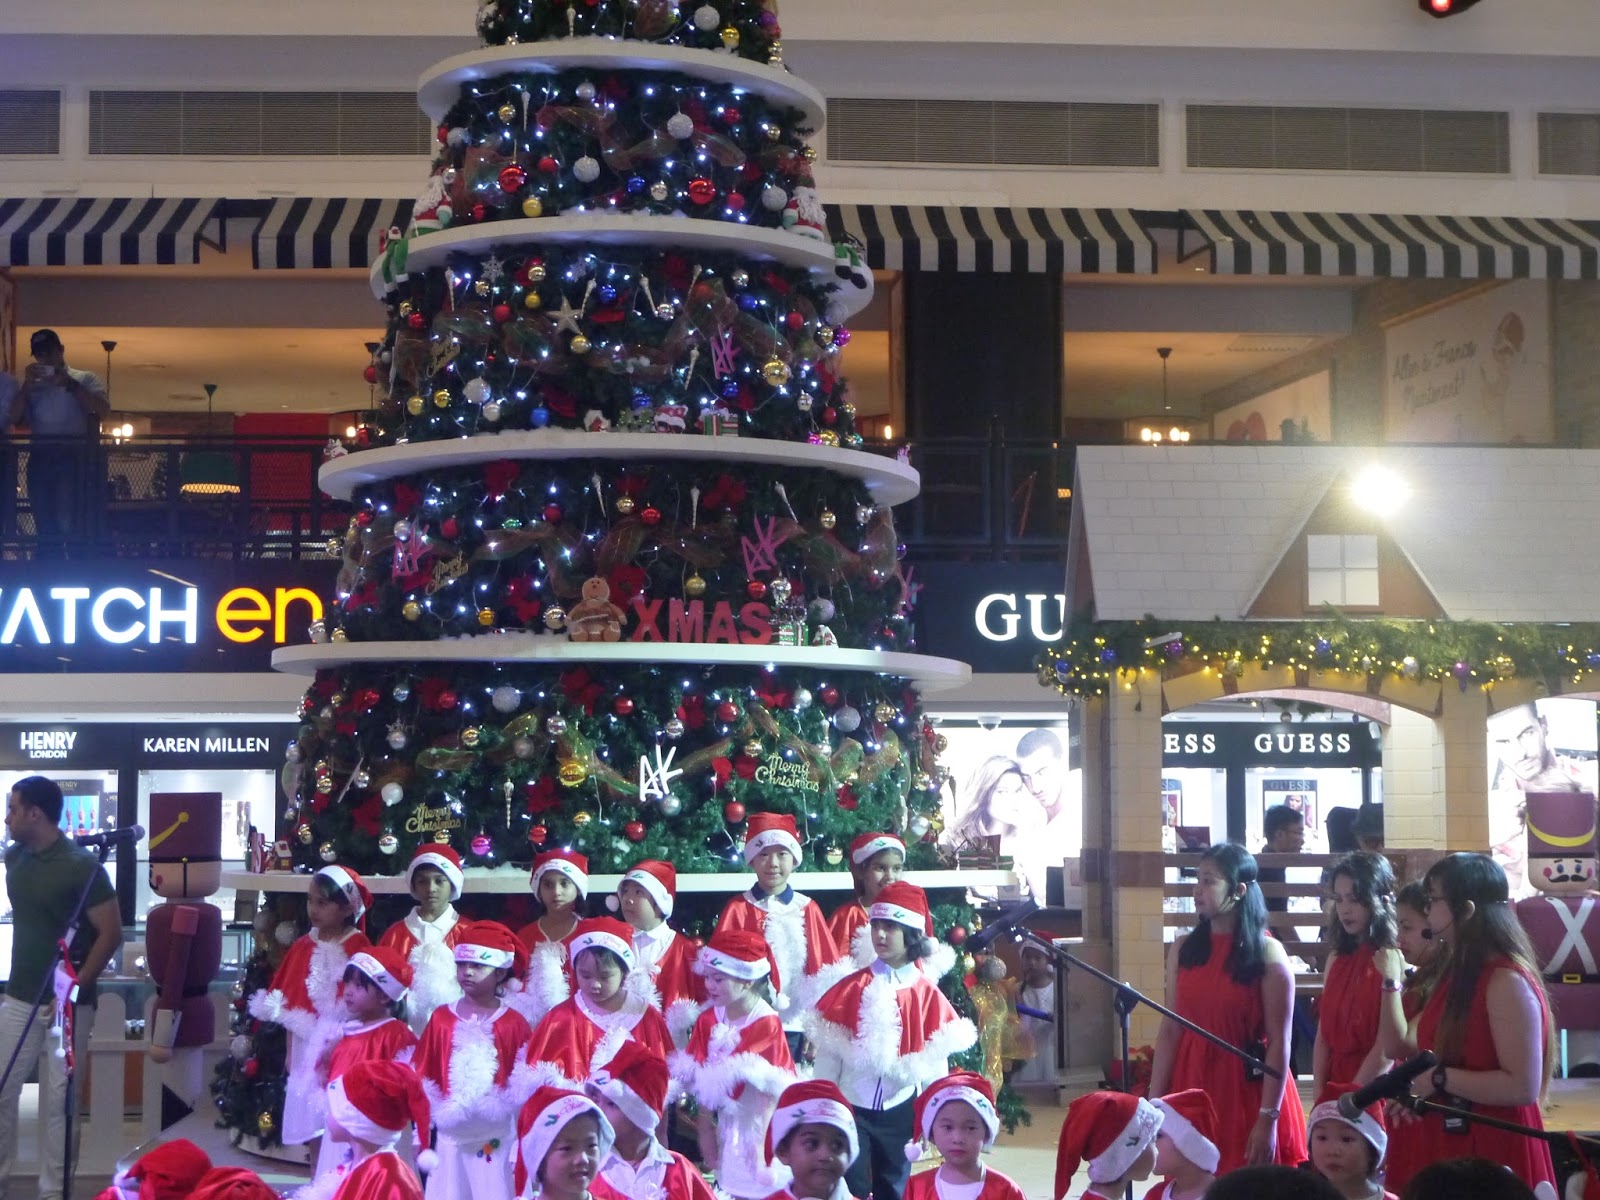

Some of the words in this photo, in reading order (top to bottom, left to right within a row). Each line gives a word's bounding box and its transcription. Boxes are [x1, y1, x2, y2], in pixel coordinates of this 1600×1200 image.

[0, 587, 198, 644] ATCH
[215, 587, 323, 644] en
[631, 599, 773, 645] XMAS
[20, 731, 78, 750] HENRY
[144, 737, 200, 753] KAREN
[205, 737, 270, 753] MILLEN
[1163, 733, 1216, 754] ESS
[1254, 733, 1351, 753] GUESS
[30, 750, 67, 758] LONDON
[1270, 780, 1311, 791] GUESS
